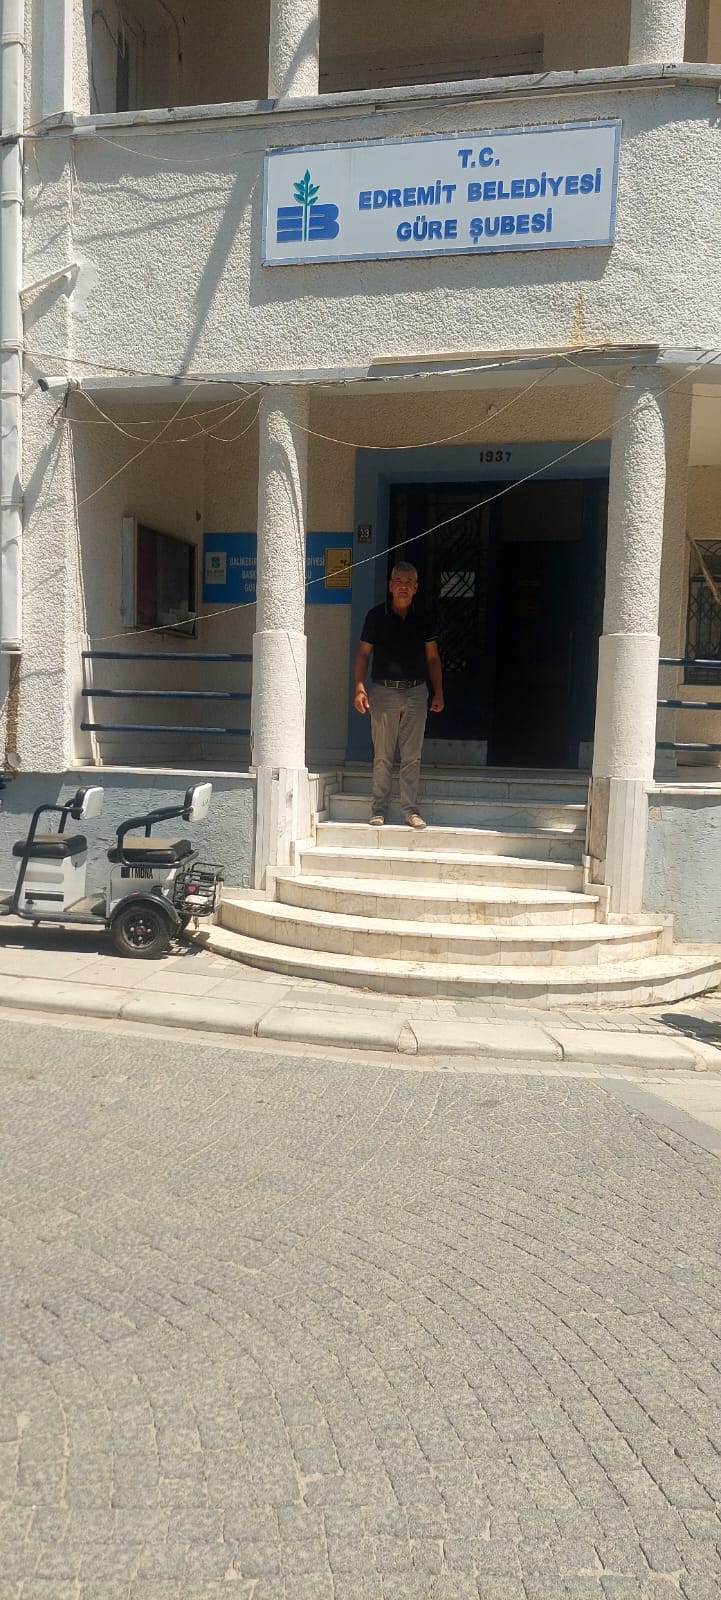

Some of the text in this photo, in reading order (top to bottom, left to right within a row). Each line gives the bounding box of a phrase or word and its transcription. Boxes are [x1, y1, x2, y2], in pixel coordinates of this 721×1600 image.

[458, 147, 500, 168] T.C.
[359, 168, 602, 210] EDREMİT BELEDİYESİ
[397, 208, 553, 244] GÜRE ŞUBESİ
[479, 450, 512, 463] 1937
